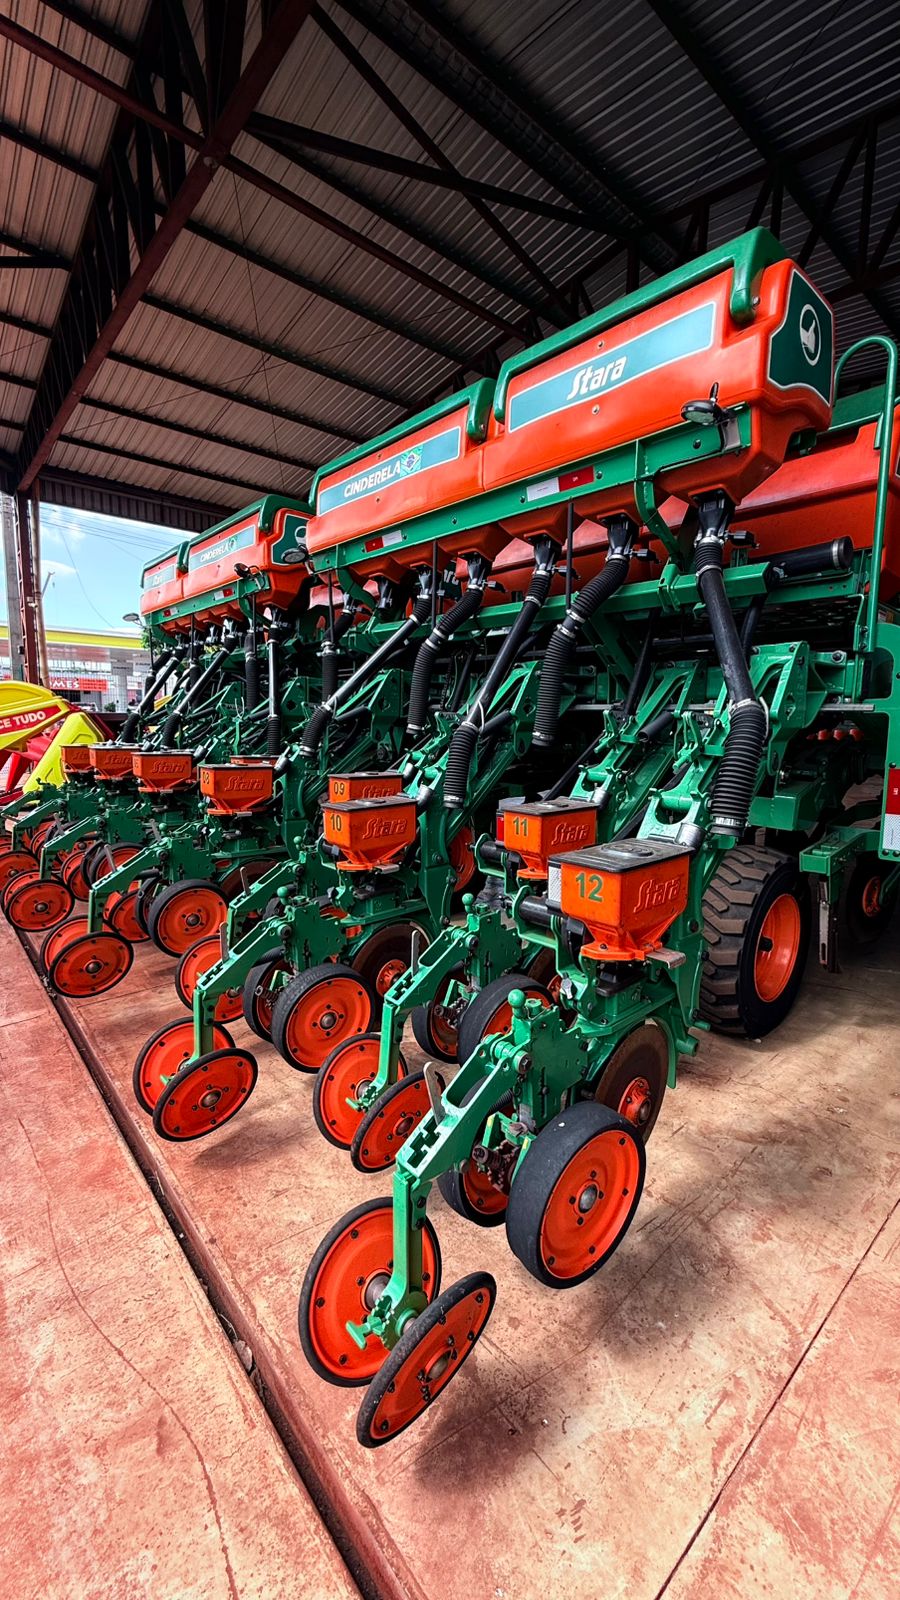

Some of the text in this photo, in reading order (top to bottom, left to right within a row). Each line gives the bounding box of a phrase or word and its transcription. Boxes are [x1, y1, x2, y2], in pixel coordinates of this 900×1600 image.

[566, 356, 627, 400] Stara
[344, 460, 400, 497] CINDERELA
[13, 711, 46, 725] TUDO
[151, 761, 185, 774] Stara
[224, 775, 265, 792] Stara
[333, 782, 346, 795] 09
[329, 813, 342, 832] 10
[361, 817, 407, 840] Stara
[512, 816, 529, 837] 11
[550, 822, 591, 846] Stara
[575, 872, 604, 903] 12
[633, 877, 682, 914] Stara
